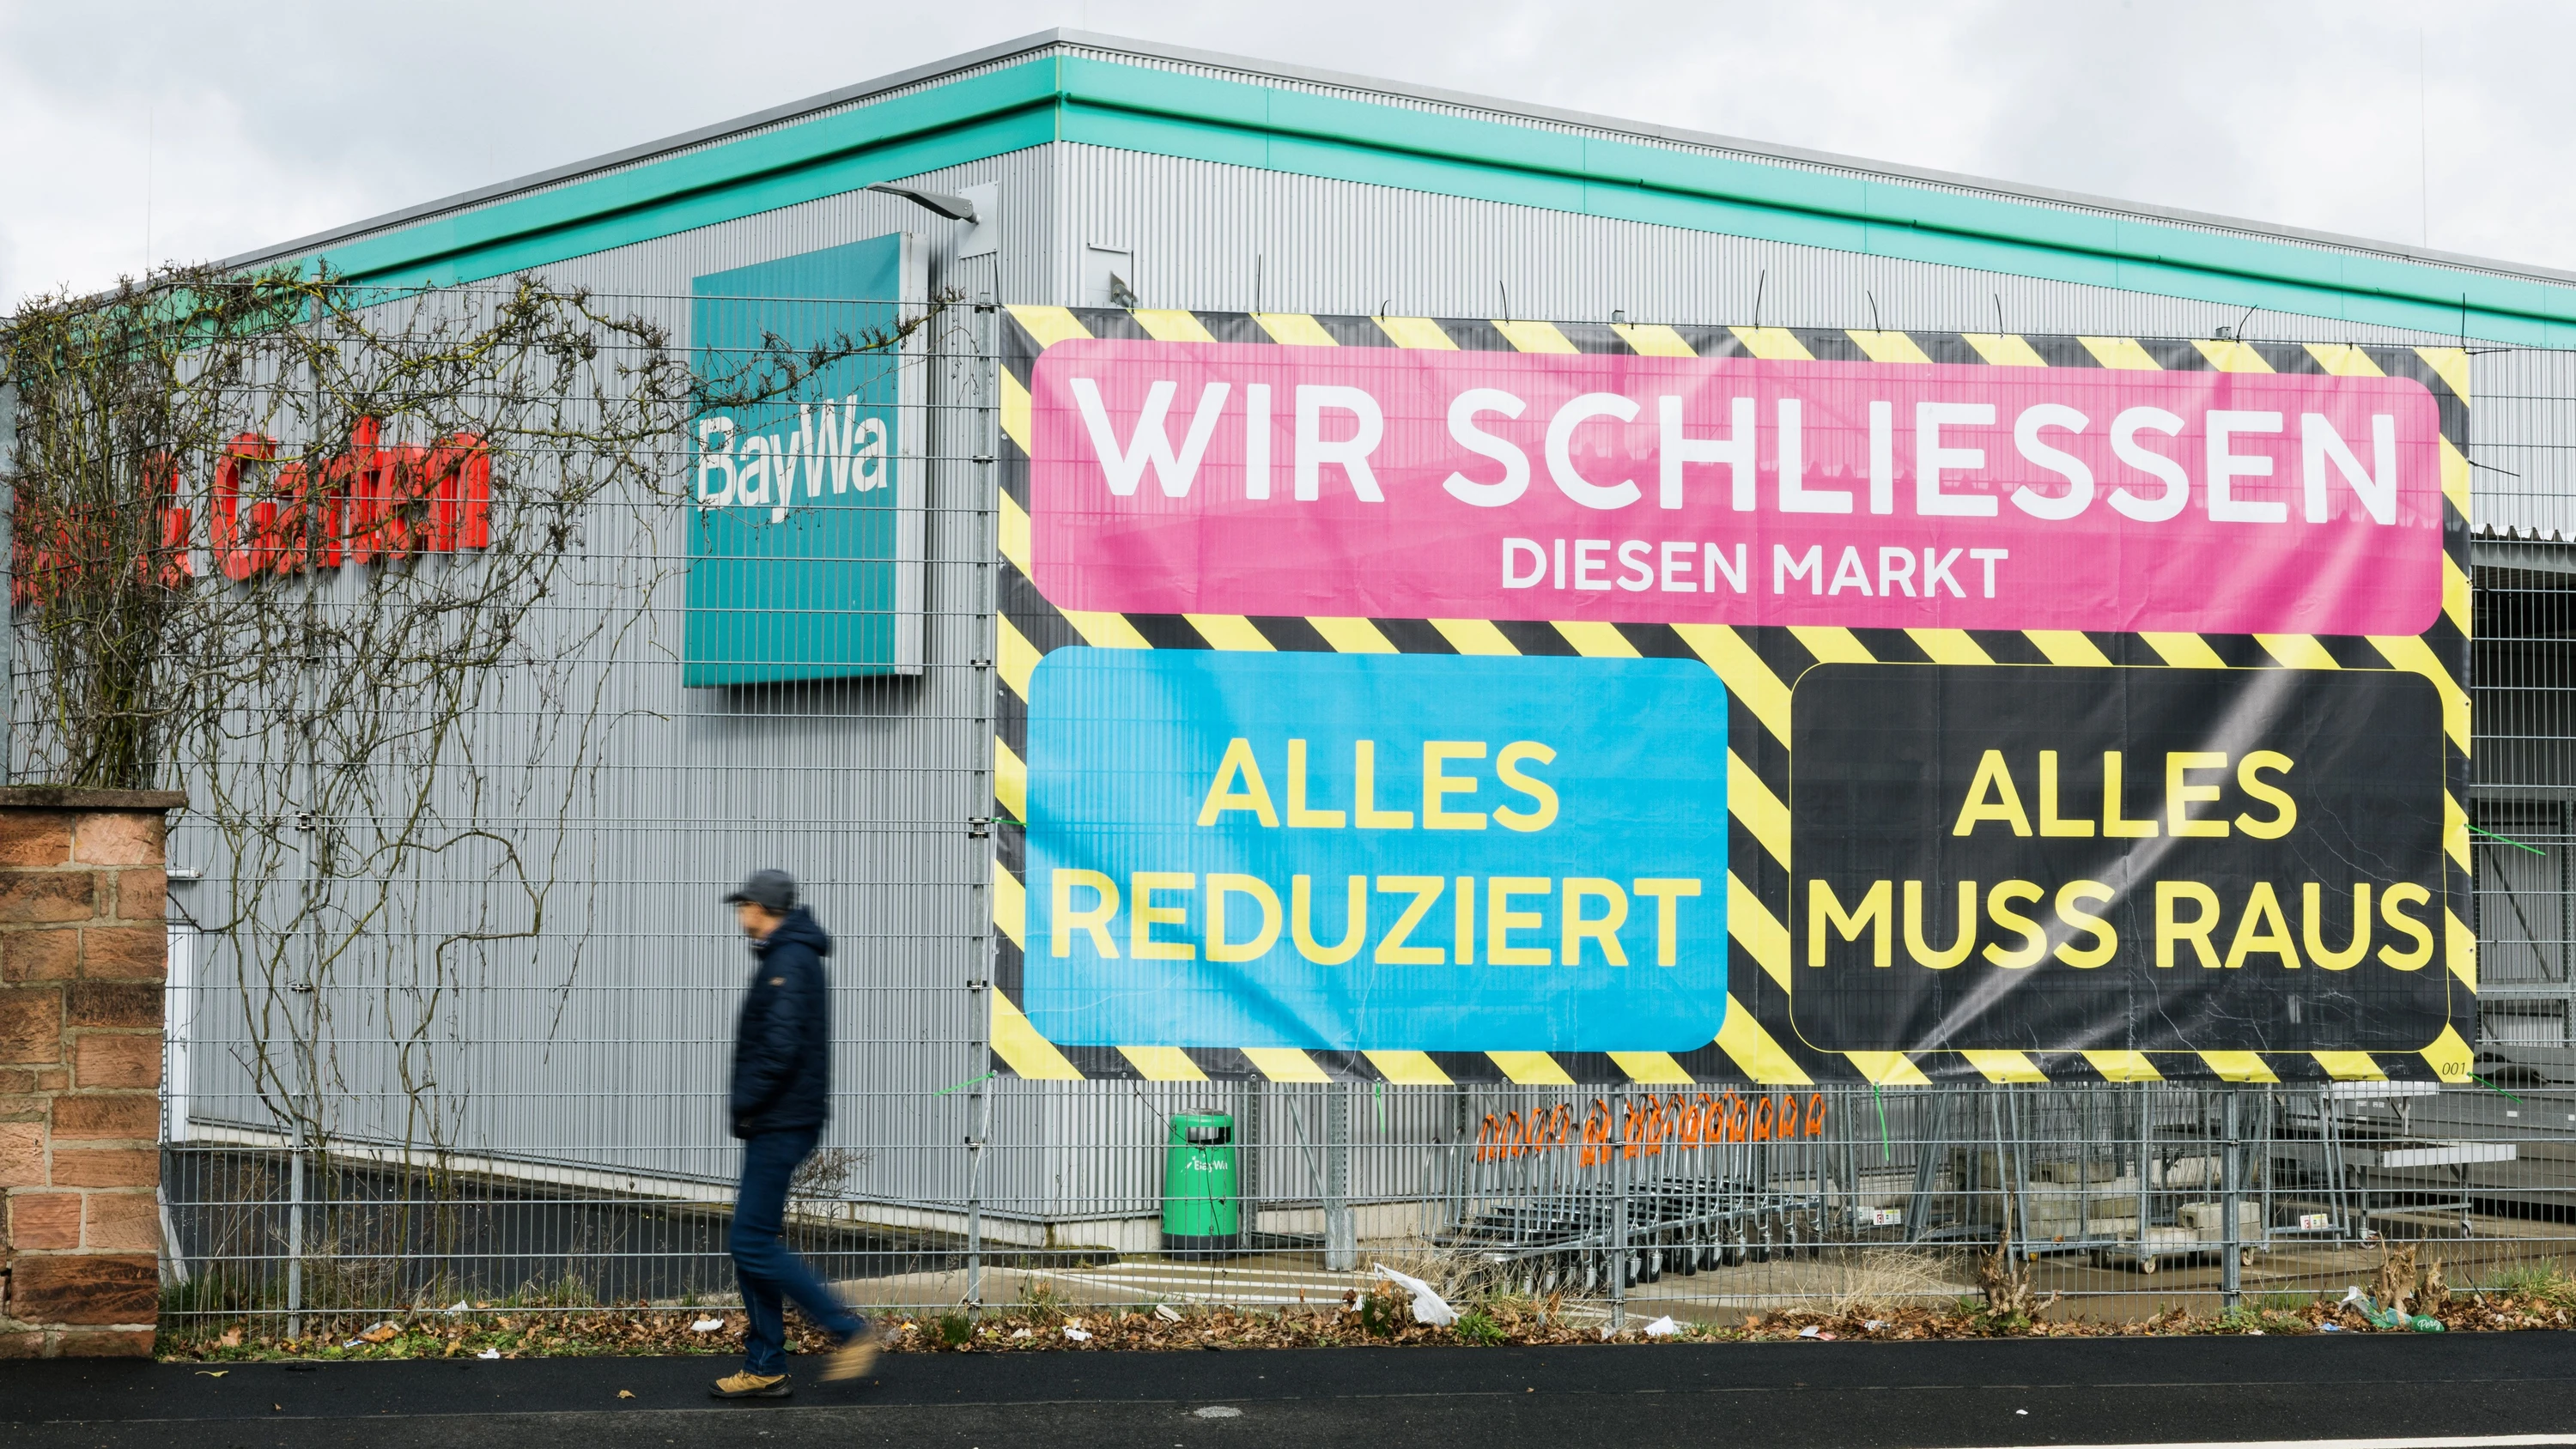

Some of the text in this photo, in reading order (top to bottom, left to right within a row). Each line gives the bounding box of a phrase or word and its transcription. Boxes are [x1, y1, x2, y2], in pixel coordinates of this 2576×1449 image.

[697, 394, 888, 524] BayWa
[1069, 377, 2398, 525] WIR SCHLIESSEN
[1502, 537, 2008, 598] DIESEN MARKT
[1198, 739, 1558, 831] ALLES
[1952, 749, 2297, 840] ALLES
[1051, 868, 1700, 967] REDUZIERT
[1807, 879, 2434, 972] MUSS RAUS
[2442, 1062, 2465, 1075] 001
[1194, 1160, 1228, 1173] BayWa
